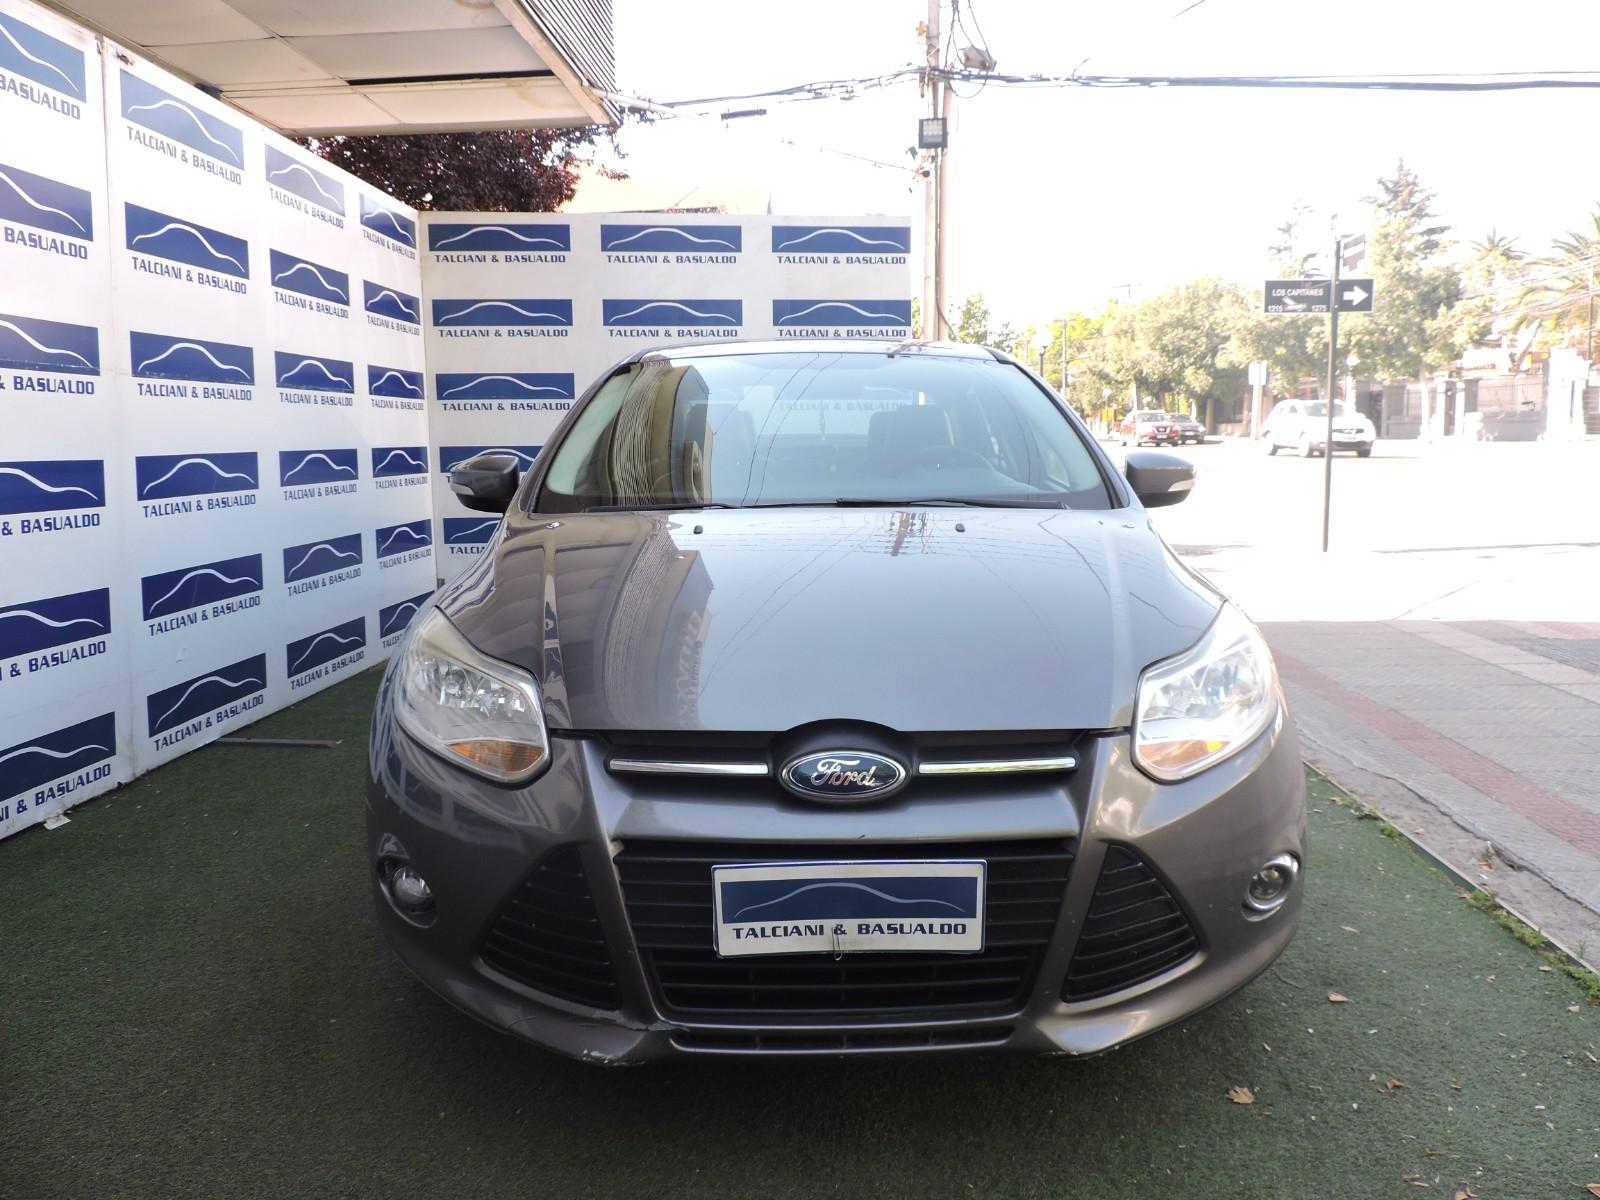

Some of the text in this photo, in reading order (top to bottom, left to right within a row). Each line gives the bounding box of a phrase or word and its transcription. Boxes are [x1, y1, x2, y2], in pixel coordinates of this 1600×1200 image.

[127, 125, 241, 185] TALCIANI & BASUALDO
[4, 226, 88, 260] BASUALDO
[435, 254, 566, 263] TALCIANI & BASUALDO
[607, 255, 736, 264] TALCIANI & BASUALDO
[777, 256, 906, 264] TALCIANI & BASUALDO
[132, 256, 247, 294] TALCIANI & BASUALDO
[439, 329, 568, 337] TALCIANI & BASUALDO
[608, 329, 738, 337] TALCIANI & BASUALDO
[778, 329, 906, 337] TALCIANI & BASUALDO
[13, 375, 95, 395] BASUALDO
[137, 383, 251, 400] TALCIANI & BASUALDO
[442, 402, 570, 411] TALCIANI & BASUALDO
[143, 494, 256, 518] TALCIANI & BASUALDO
[1, 513, 100, 536] & BASUALDO
[149, 596, 260, 636] TALCIANI & BASUALDO
[10, 663, 21, 677] &
[29, 640, 106, 672] BASUALDO
[154, 695, 264, 751] TALCIANI & BASUALDO
[811, 758, 880, 786] Ford
[16, 799, 28, 814] &
[35, 763, 111, 806] BASUALDO
[733, 923, 967, 939] TALCIANI & BASUALDO
